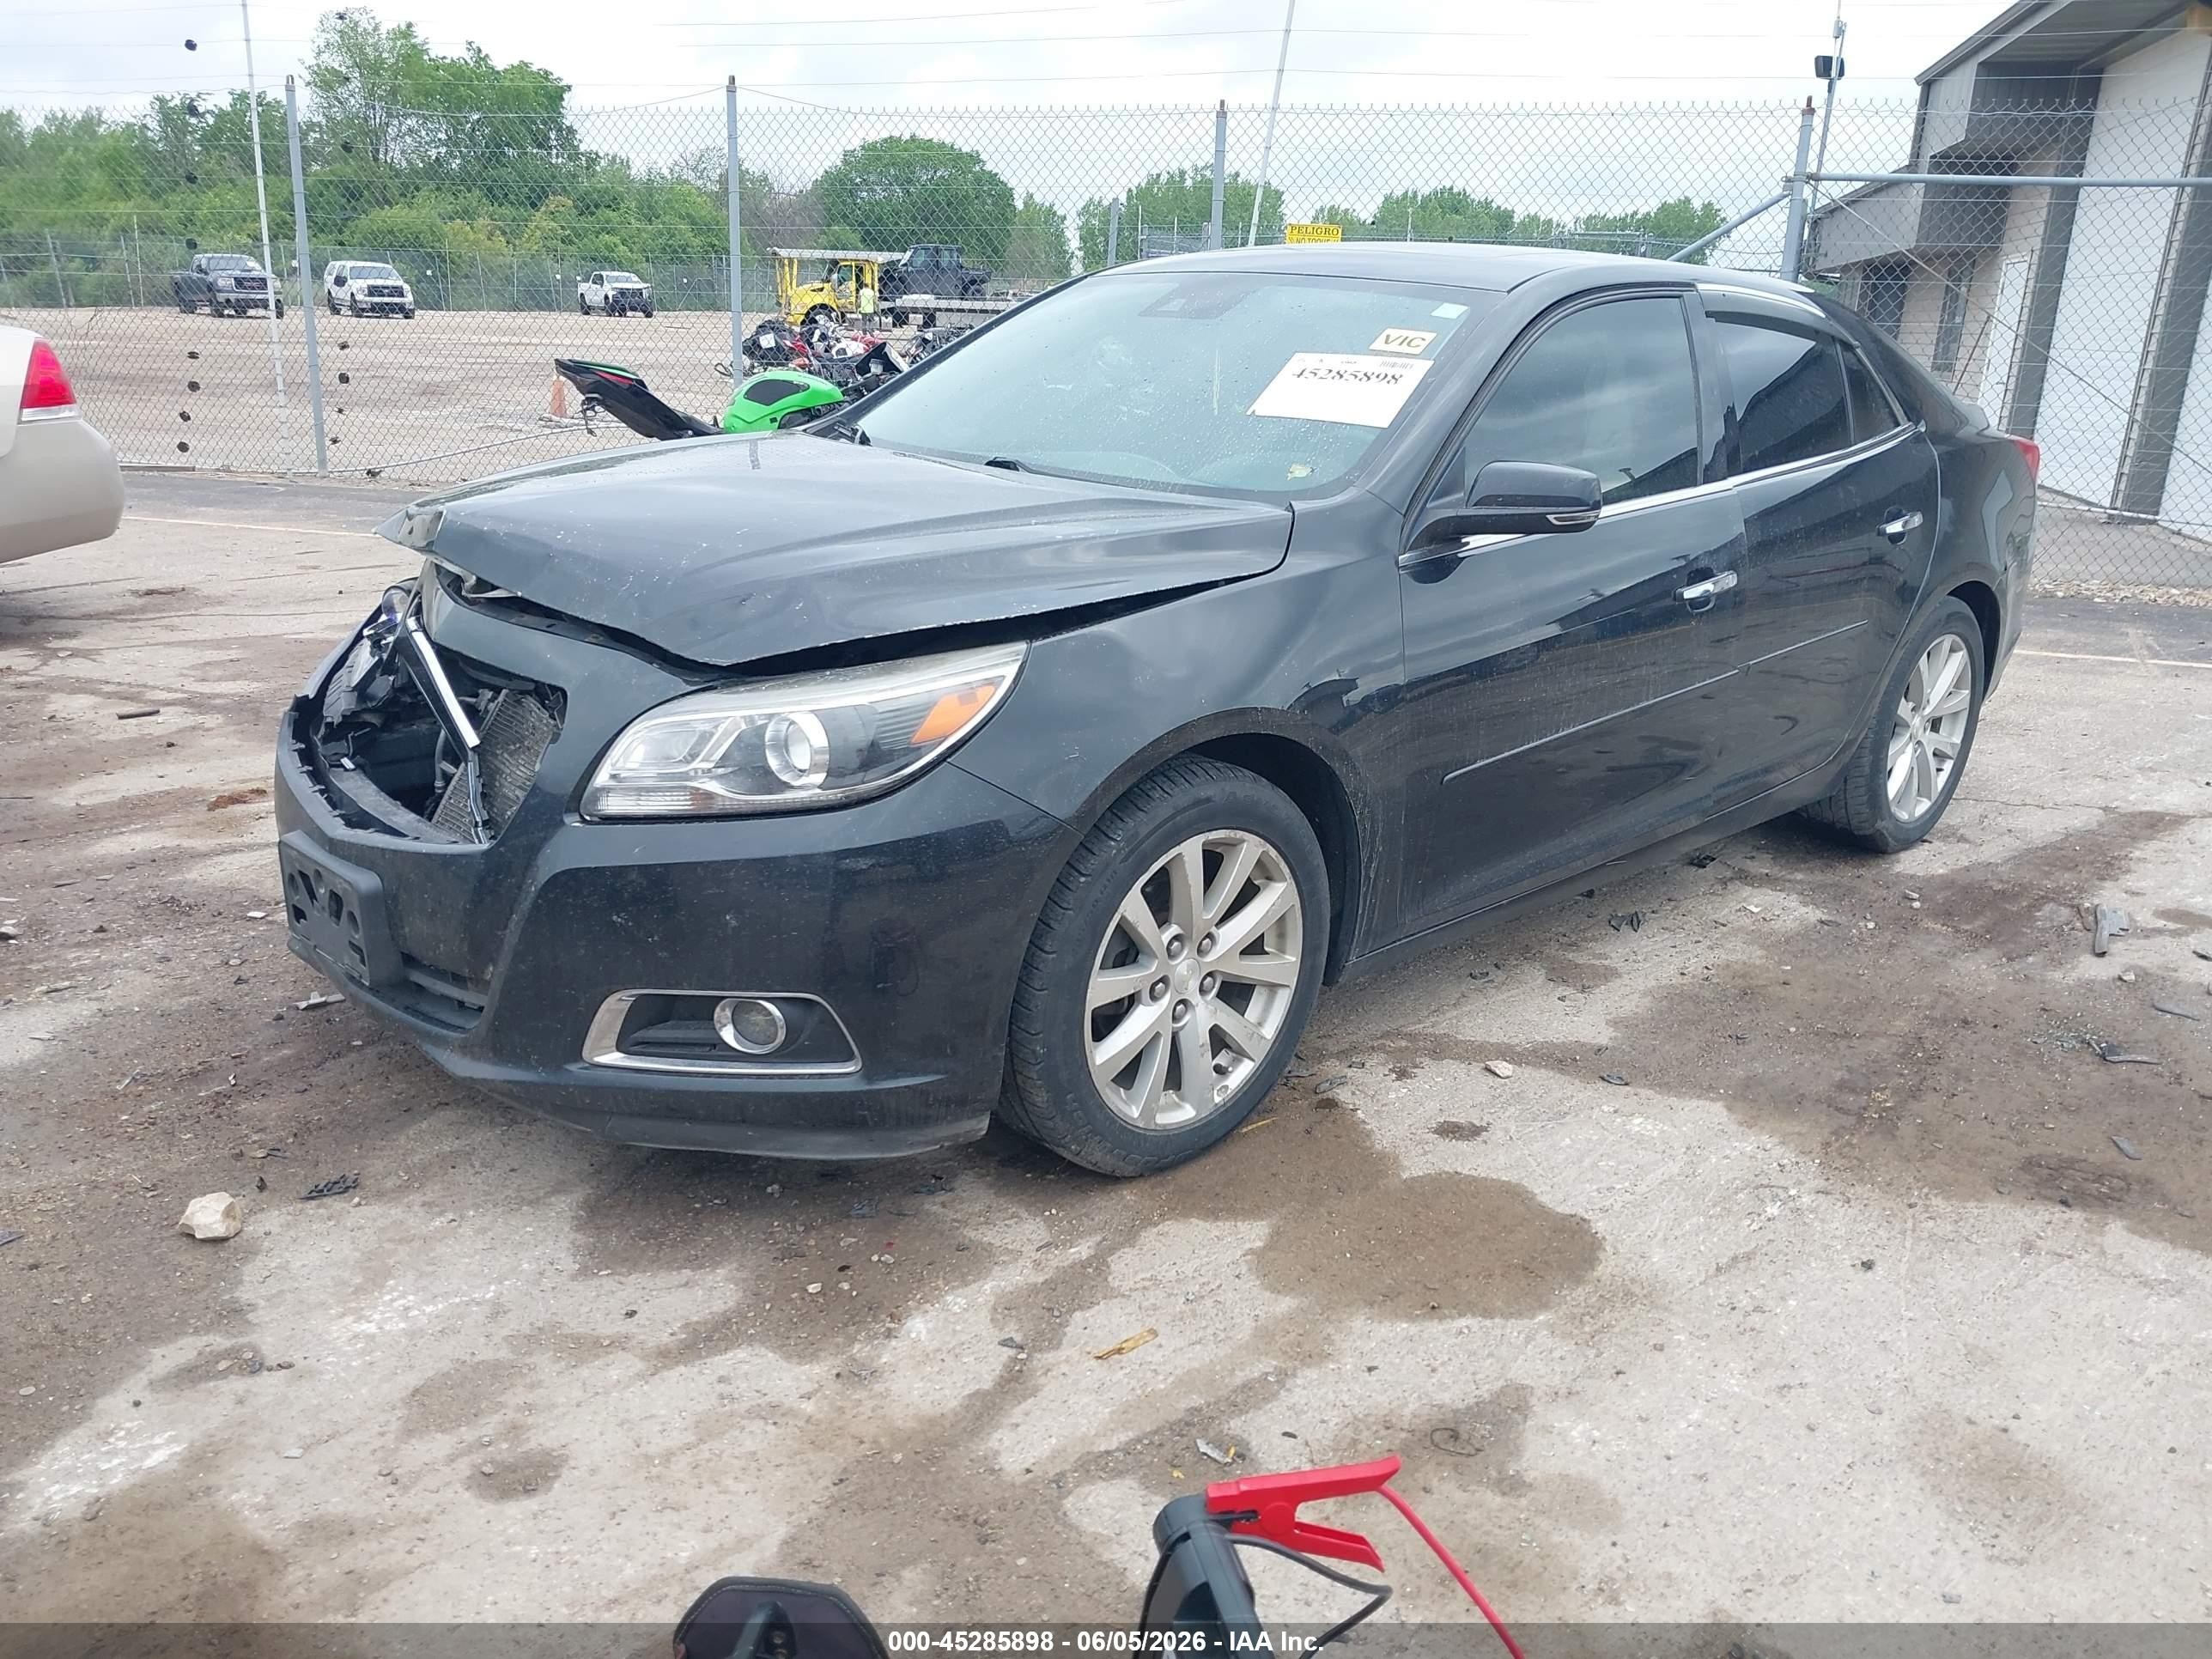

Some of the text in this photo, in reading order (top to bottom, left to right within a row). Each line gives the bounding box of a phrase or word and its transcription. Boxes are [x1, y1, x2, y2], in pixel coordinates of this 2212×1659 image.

[1290, 226, 1340, 236] PELIGRO
[1383, 333, 1426, 349] VIC
[1291, 367, 1404, 386] 45285898
